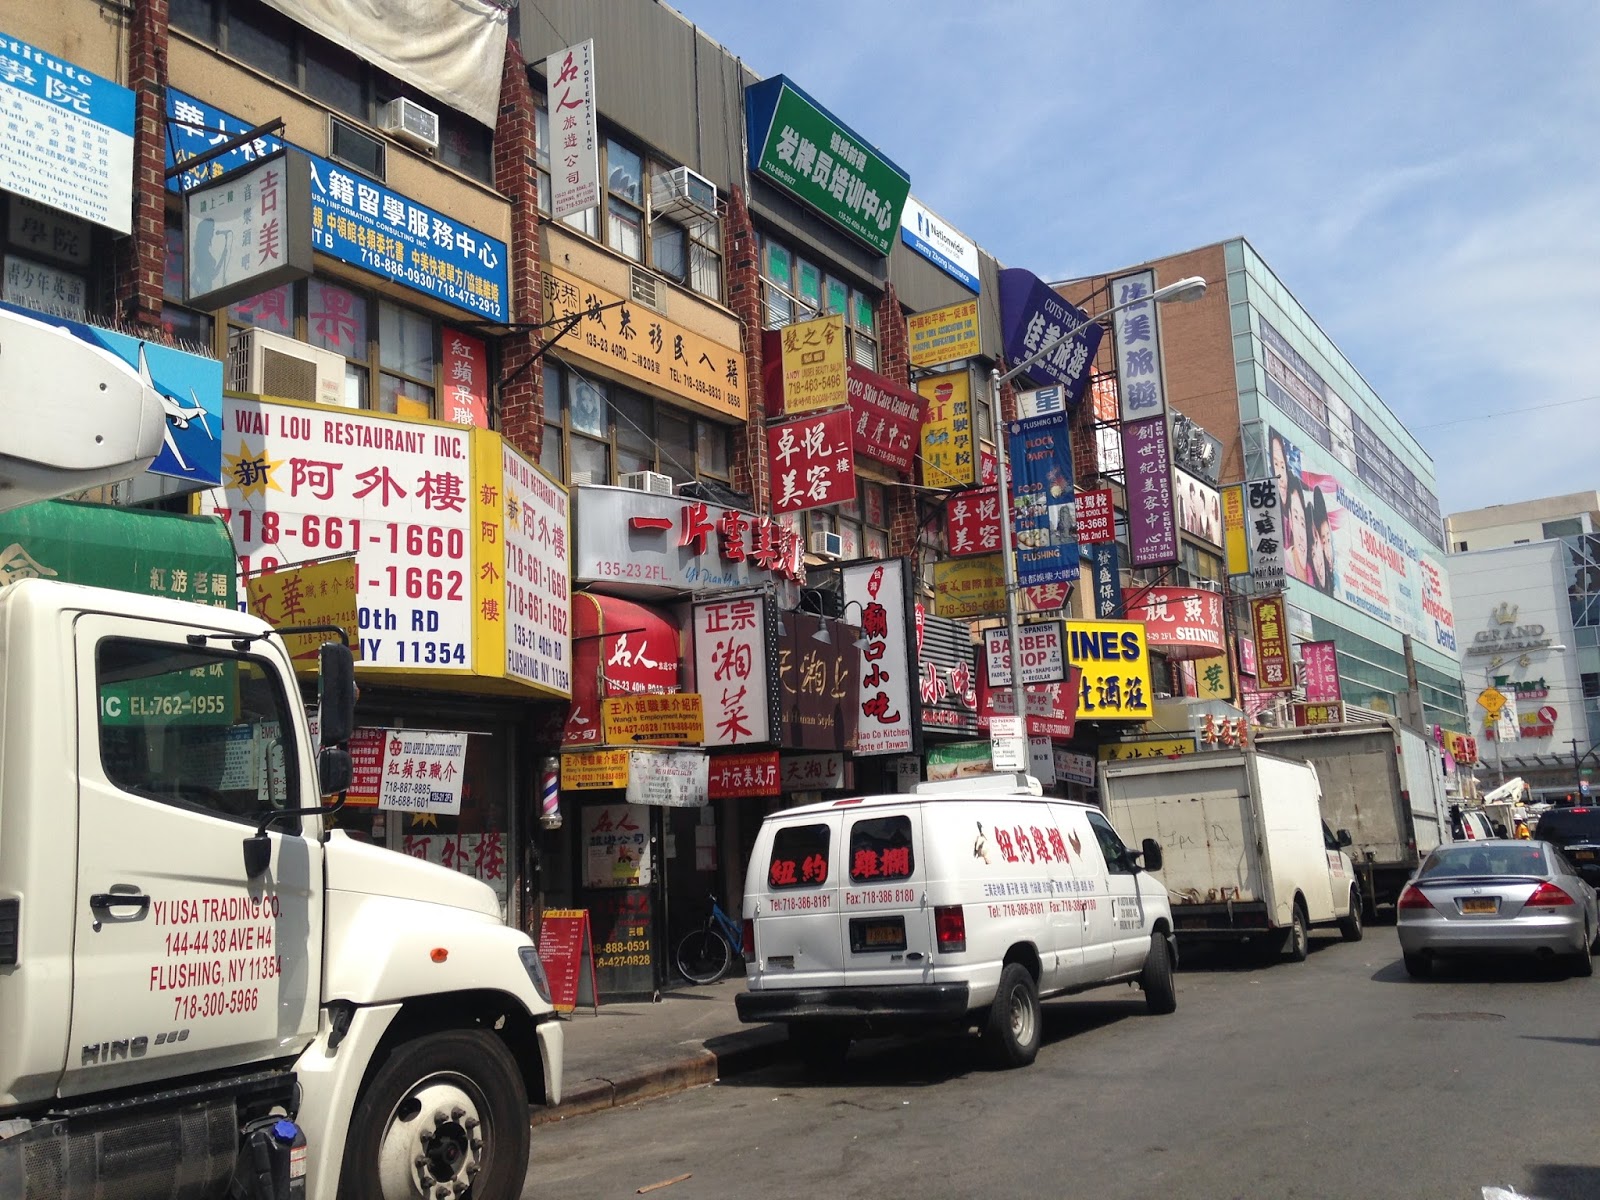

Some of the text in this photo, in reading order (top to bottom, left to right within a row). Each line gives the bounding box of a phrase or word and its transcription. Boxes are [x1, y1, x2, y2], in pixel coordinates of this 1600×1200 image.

[17, 91, 110, 136] Leadership Training
[584, 69, 592, 126] ORIENTAL
[9, 170, 48, 190] Asylum
[51, 186, 109, 213] Application
[38, 167, 109, 200] Chinese Class
[73, 170, 109, 189] Science
[776, 125, 893, 232] 发牌员培训中心
[330, 203, 374, 225] INFORMATION
[376, 221, 414, 243] CONSULTING
[931, 223, 964, 255] Nationwide
[948, 261, 970, 283] Insurance
[437, 279, 501, 318] 718-475-2912
[1045, 298, 1063, 321] COTS
[586, 334, 608, 353] 135-23
[863, 383, 878, 403] Skin
[877, 388, 892, 410] Care
[891, 396, 910, 418] Center
[235, 409, 467, 460] WAI LOU RESTAURANT INC.
[1023, 415, 1063, 430] FLUSHING BID
[1157, 439, 1167, 475] CENTURY
[289, 457, 467, 513] 阿外樓
[531, 474, 557, 512] RESTAURANT
[777, 465, 832, 507] 美容
[1160, 478, 1170, 509] BEAUTY
[522, 500, 566, 562] 阿外樓
[1163, 511, 1172, 543] CENTER
[1336, 484, 1404, 553] Affordable Family Dental
[480, 483, 500, 622] 新阿外樓
[952, 525, 999, 552] 美容
[505, 542, 567, 601] 718-661-1660
[596, 560, 642, 577] 135-23
[1268, 565, 1284, 577] Salon
[411, 610, 440, 632] RD
[506, 580, 567, 636] 718-661-1662
[705, 601, 756, 634] 正宗
[1422, 588, 1454, 629] American
[513, 623, 563, 661] 135-21 40th RD
[1024, 625, 1053, 634] SPANISH
[1176, 626, 1219, 645] SHINING
[1435, 620, 1457, 652] Dental
[1475, 625, 1544, 642] GRAND
[396, 640, 466, 665] 11354
[861, 602, 901, 724] 廟口小吃
[1002, 651, 1047, 669] SOP
[1263, 647, 1282, 657] SPA
[508, 648, 570, 690] FLUSHING NY 11354
[1267, 670, 1282, 680] 24
[613, 715, 638, 723] Wang's
[640, 713, 678, 721] Employment
[872, 727, 911, 740] Co Kitchen
[876, 739, 909, 750] of Taiwan
[387, 759, 458, 783] 紅蘋果職介
[385, 781, 431, 795] 718-887-8885
[770, 853, 829, 886] 紐約
[153, 895, 283, 926] YI USA TRADING CO.
[846, 892, 861, 906] Fax:
[988, 901, 1045, 918] Tel: 718-386-8181
[166, 926, 272, 957] 144-44 38 AVE H4
[150, 955, 282, 991] FLUSHING, NY 11354
[174, 988, 258, 1021] 718-300-5966
[81, 1036, 148, 1066] HINO
